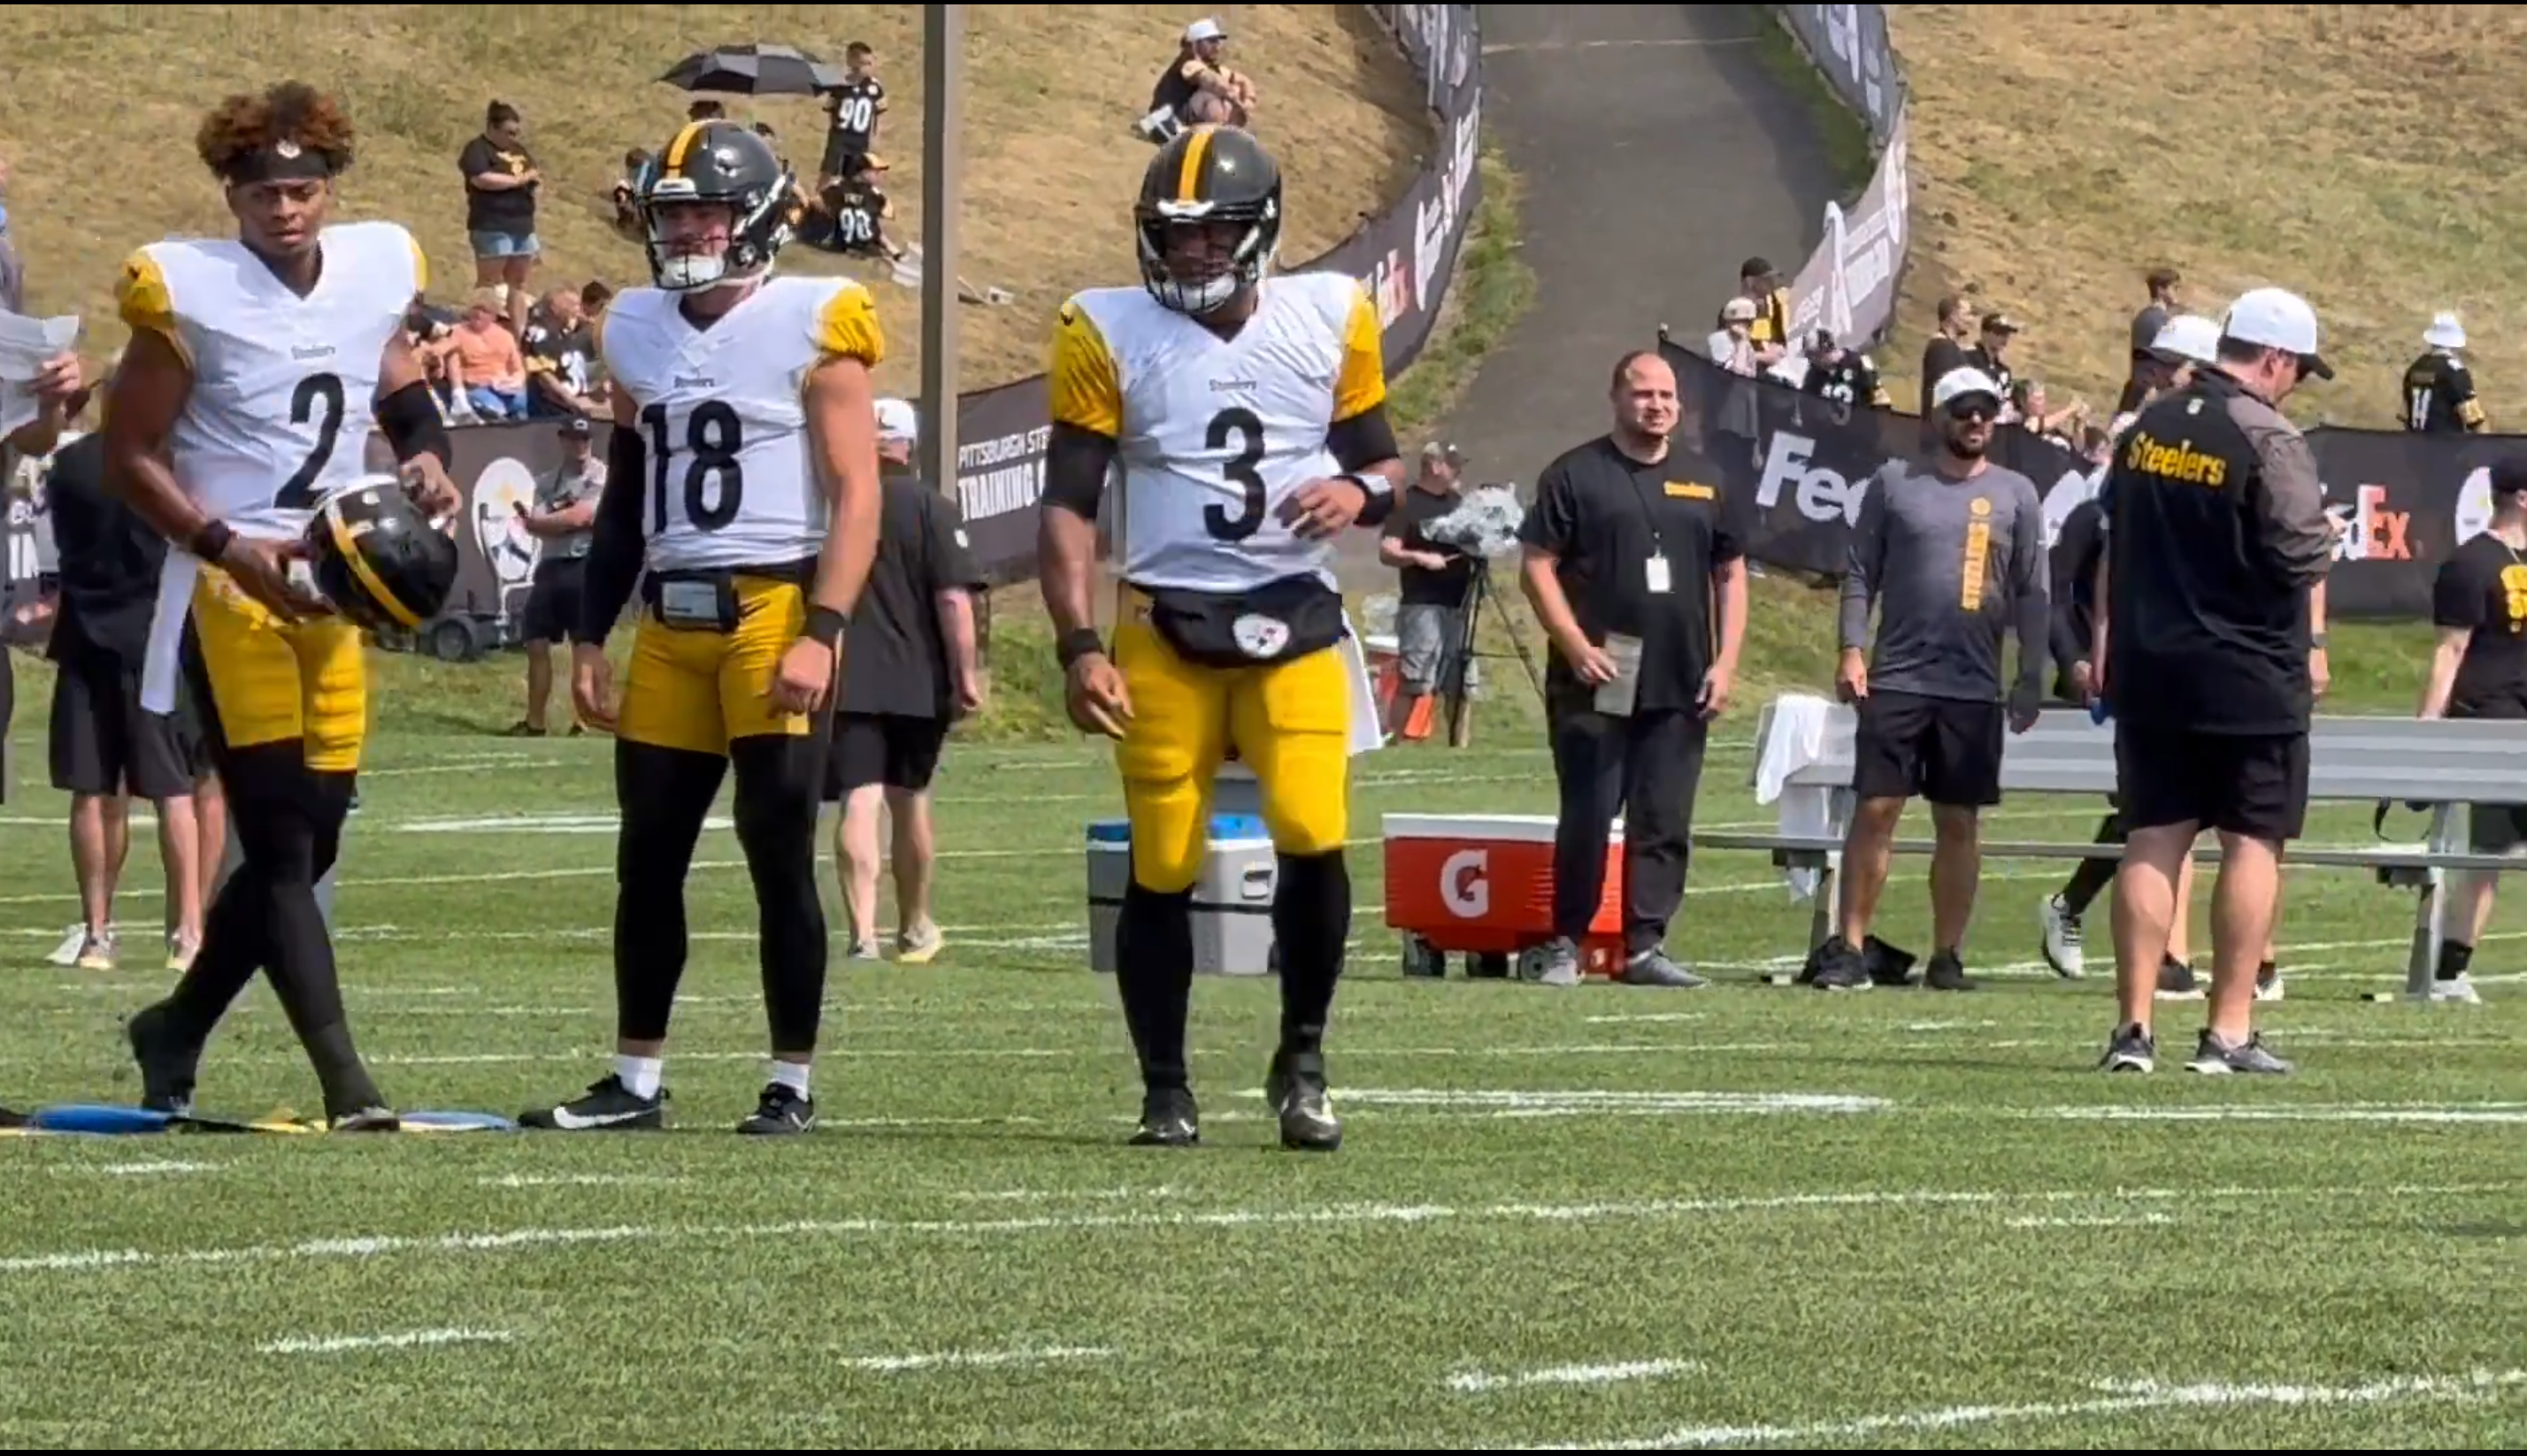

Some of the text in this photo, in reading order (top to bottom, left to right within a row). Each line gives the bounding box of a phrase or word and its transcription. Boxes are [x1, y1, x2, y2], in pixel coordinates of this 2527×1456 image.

[837, 96, 872, 133] 90
[273, 372, 345, 510] 2
[641, 400, 742, 533] 18
[958, 432, 1027, 471] PITTSBURGH
[2126, 431, 2226, 486] Steelers
[957, 464, 1038, 523] TRAINING
[1203, 406, 1267, 542] 3
[1440, 849, 1489, 918] G
